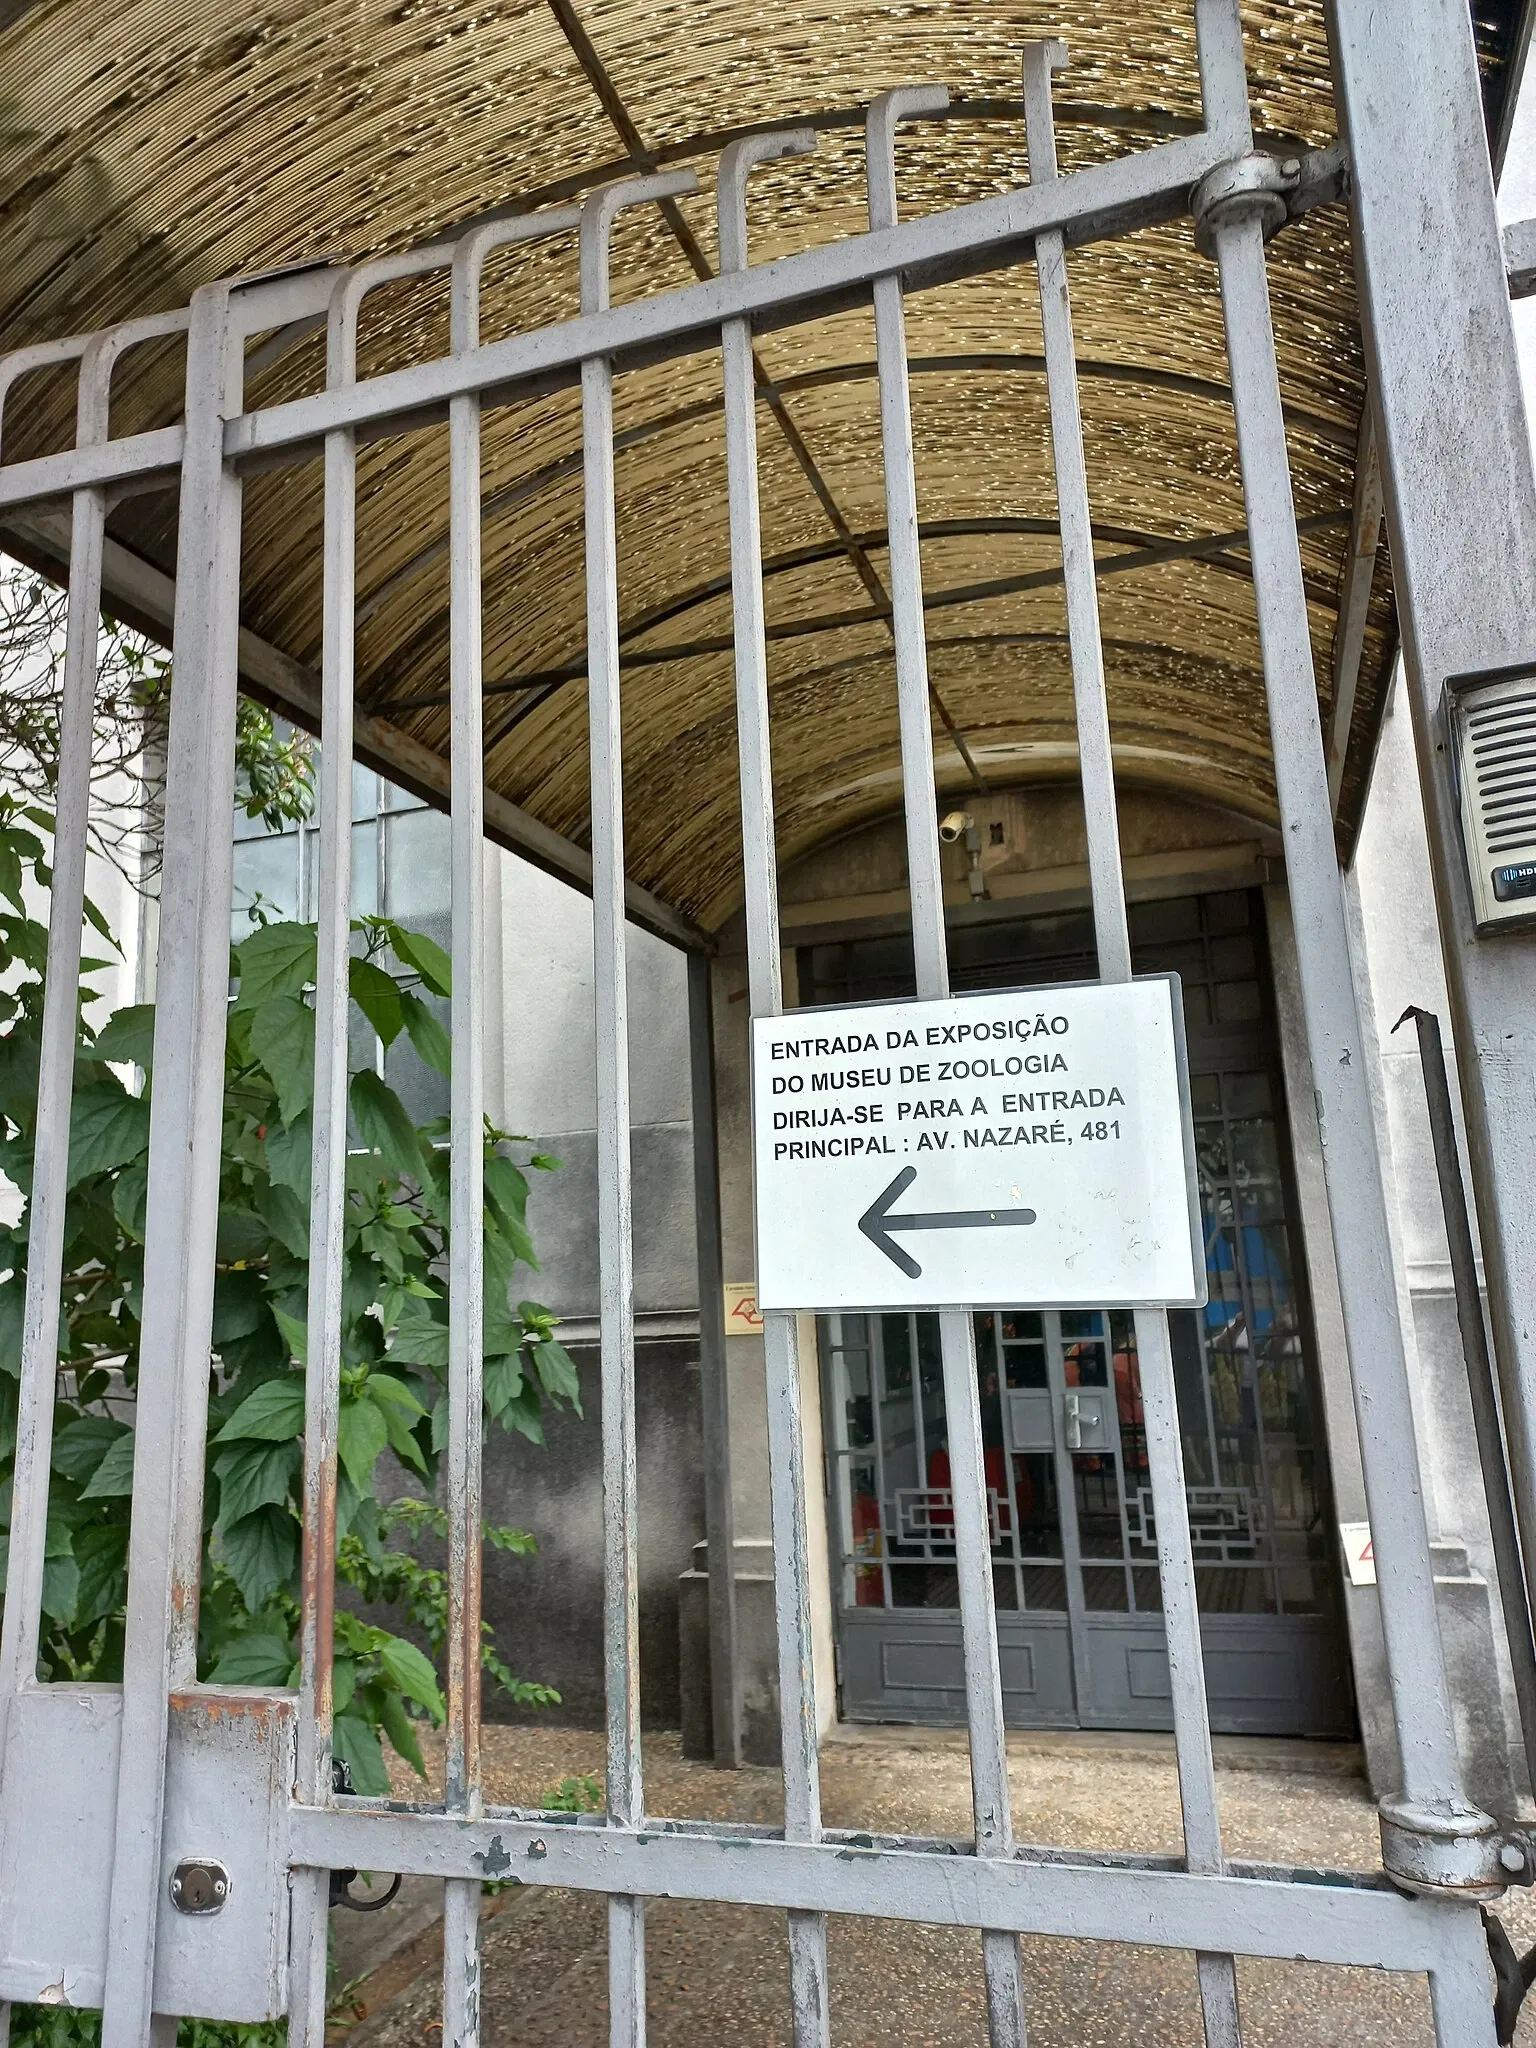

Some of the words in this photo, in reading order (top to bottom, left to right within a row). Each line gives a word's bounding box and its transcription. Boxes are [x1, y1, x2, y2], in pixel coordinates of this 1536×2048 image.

[771, 1033, 880, 1061] ENTRADA
[886, 1029, 920, 1050] DA
[925, 1012, 1070, 1046] EXPOSIÇÃO
[772, 1075, 804, 1095] DO
[811, 1067, 892, 1092] MUSEU
[899, 1063, 931, 1085] DE
[937, 1053, 1069, 1081] ZOOLOGIA
[773, 1103, 884, 1131] DIRIJA-SE
[897, 1097, 965, 1121] PARA
[970, 1096, 989, 1116] A
[1002, 1086, 1126, 1114] ENTRADA
[774, 1135, 896, 1161] PRINCIPAL
[916, 1131, 956, 1152] AV.
[963, 1119, 1074, 1149] NAZARÉ,
[1080, 1120, 1121, 1142] 481
